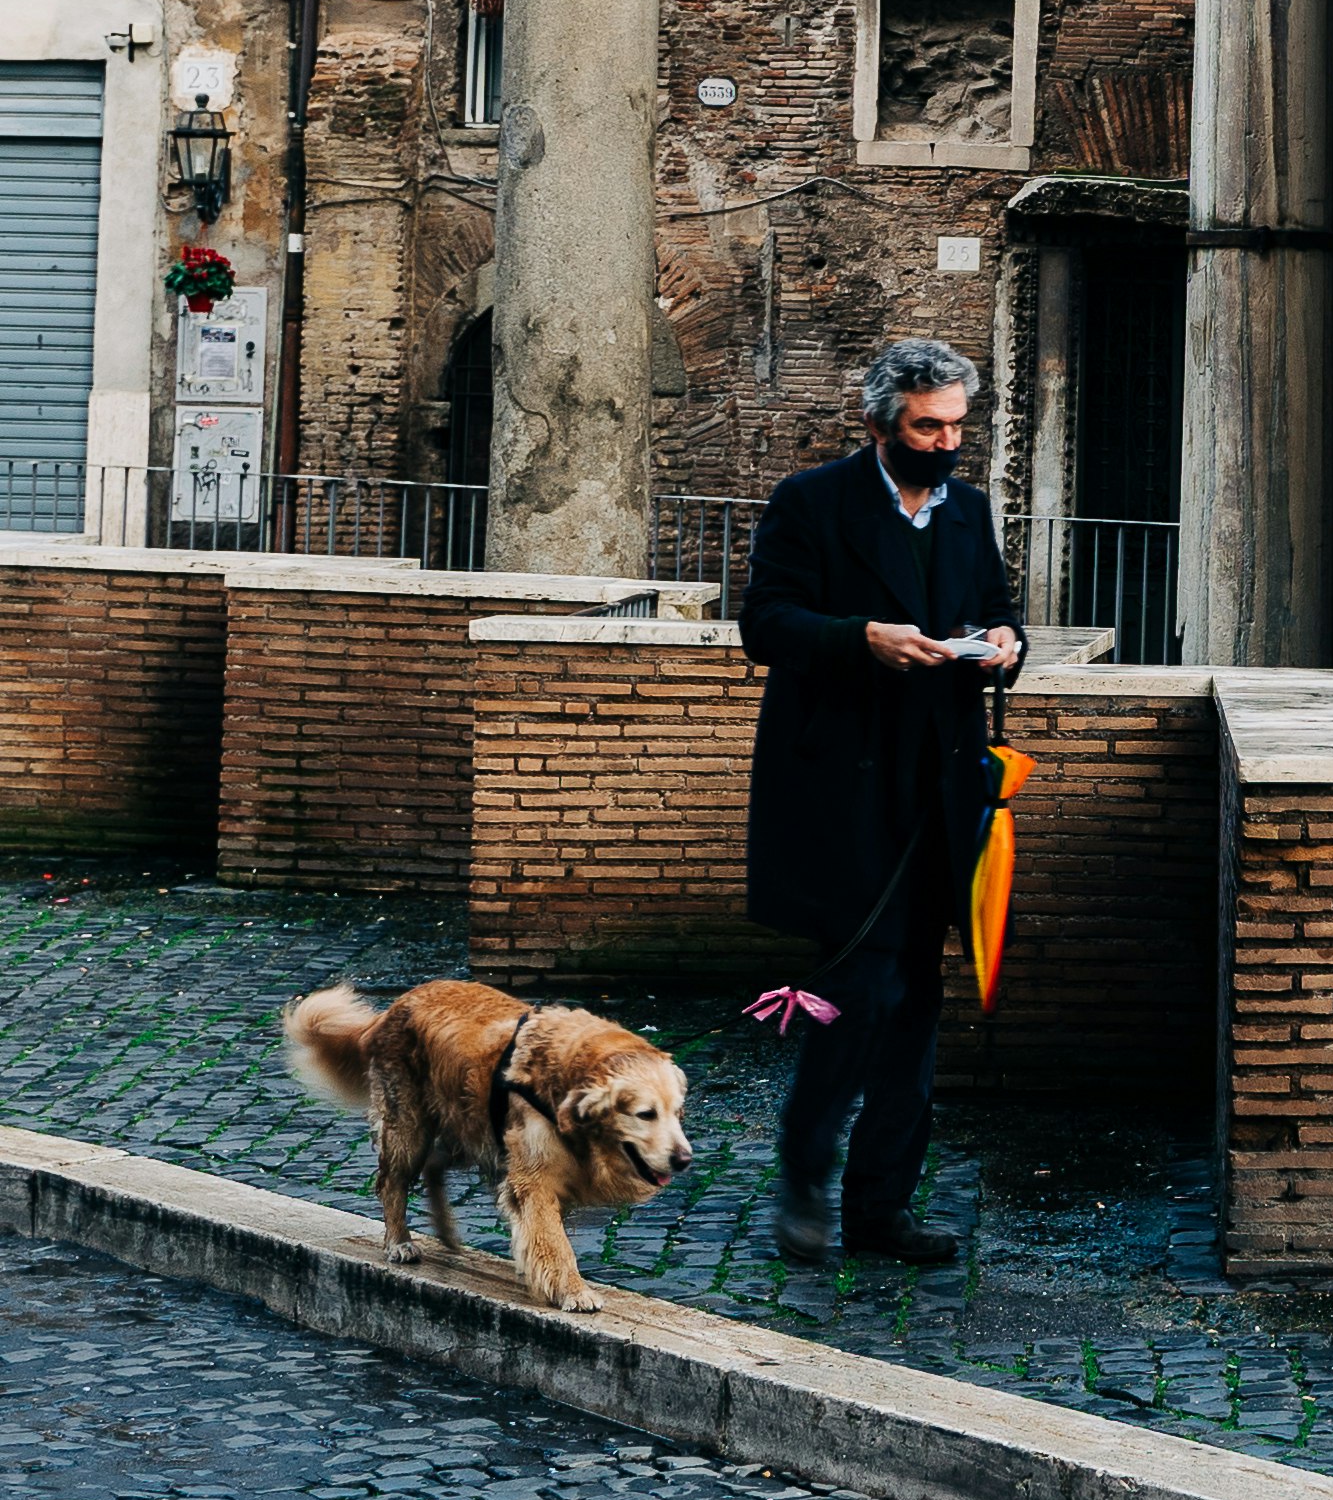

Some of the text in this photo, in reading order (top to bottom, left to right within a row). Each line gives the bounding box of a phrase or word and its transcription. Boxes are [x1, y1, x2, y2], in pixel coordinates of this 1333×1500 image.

[186, 66, 220, 89] 23
[701, 85, 733, 99] 3339
[946, 245, 970, 262] 25
